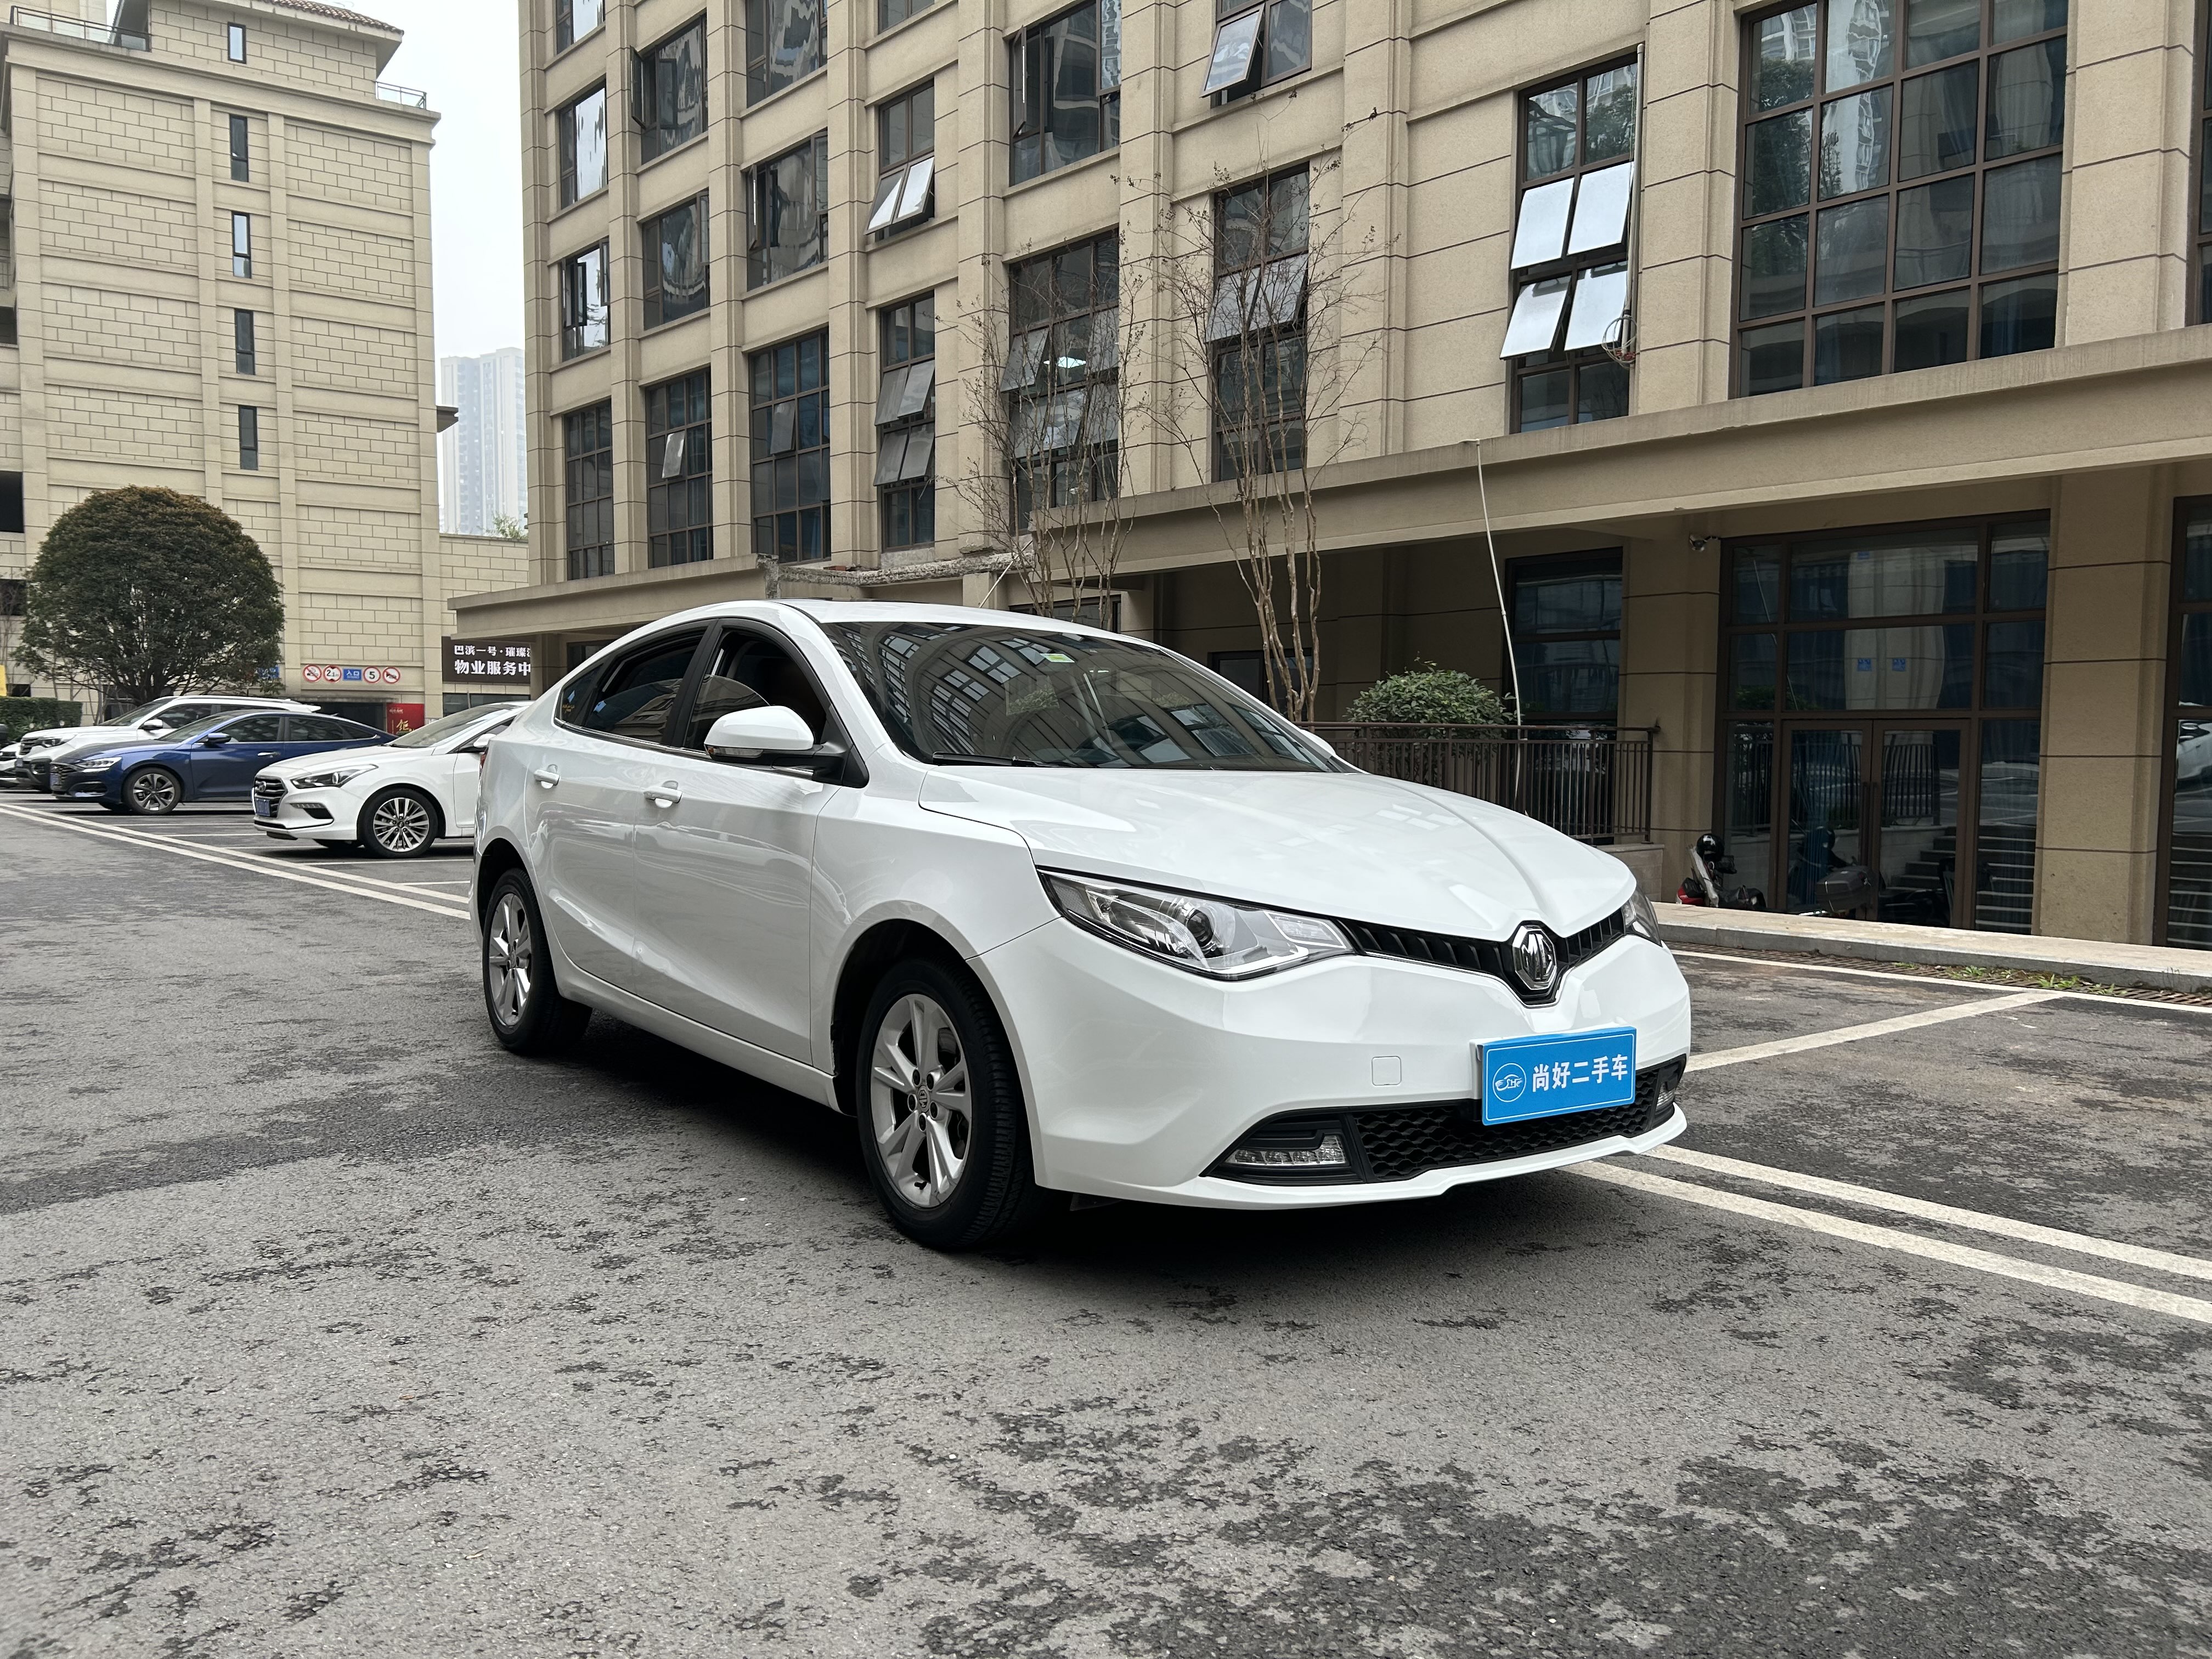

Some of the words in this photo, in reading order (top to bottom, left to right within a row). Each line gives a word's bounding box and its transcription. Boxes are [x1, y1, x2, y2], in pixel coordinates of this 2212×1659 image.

[454, 645, 531, 657] 巴滨一号·璀璨
[454, 659, 531, 676] 物业服务中
[1532, 1054, 1628, 1092] 尚好二手车
